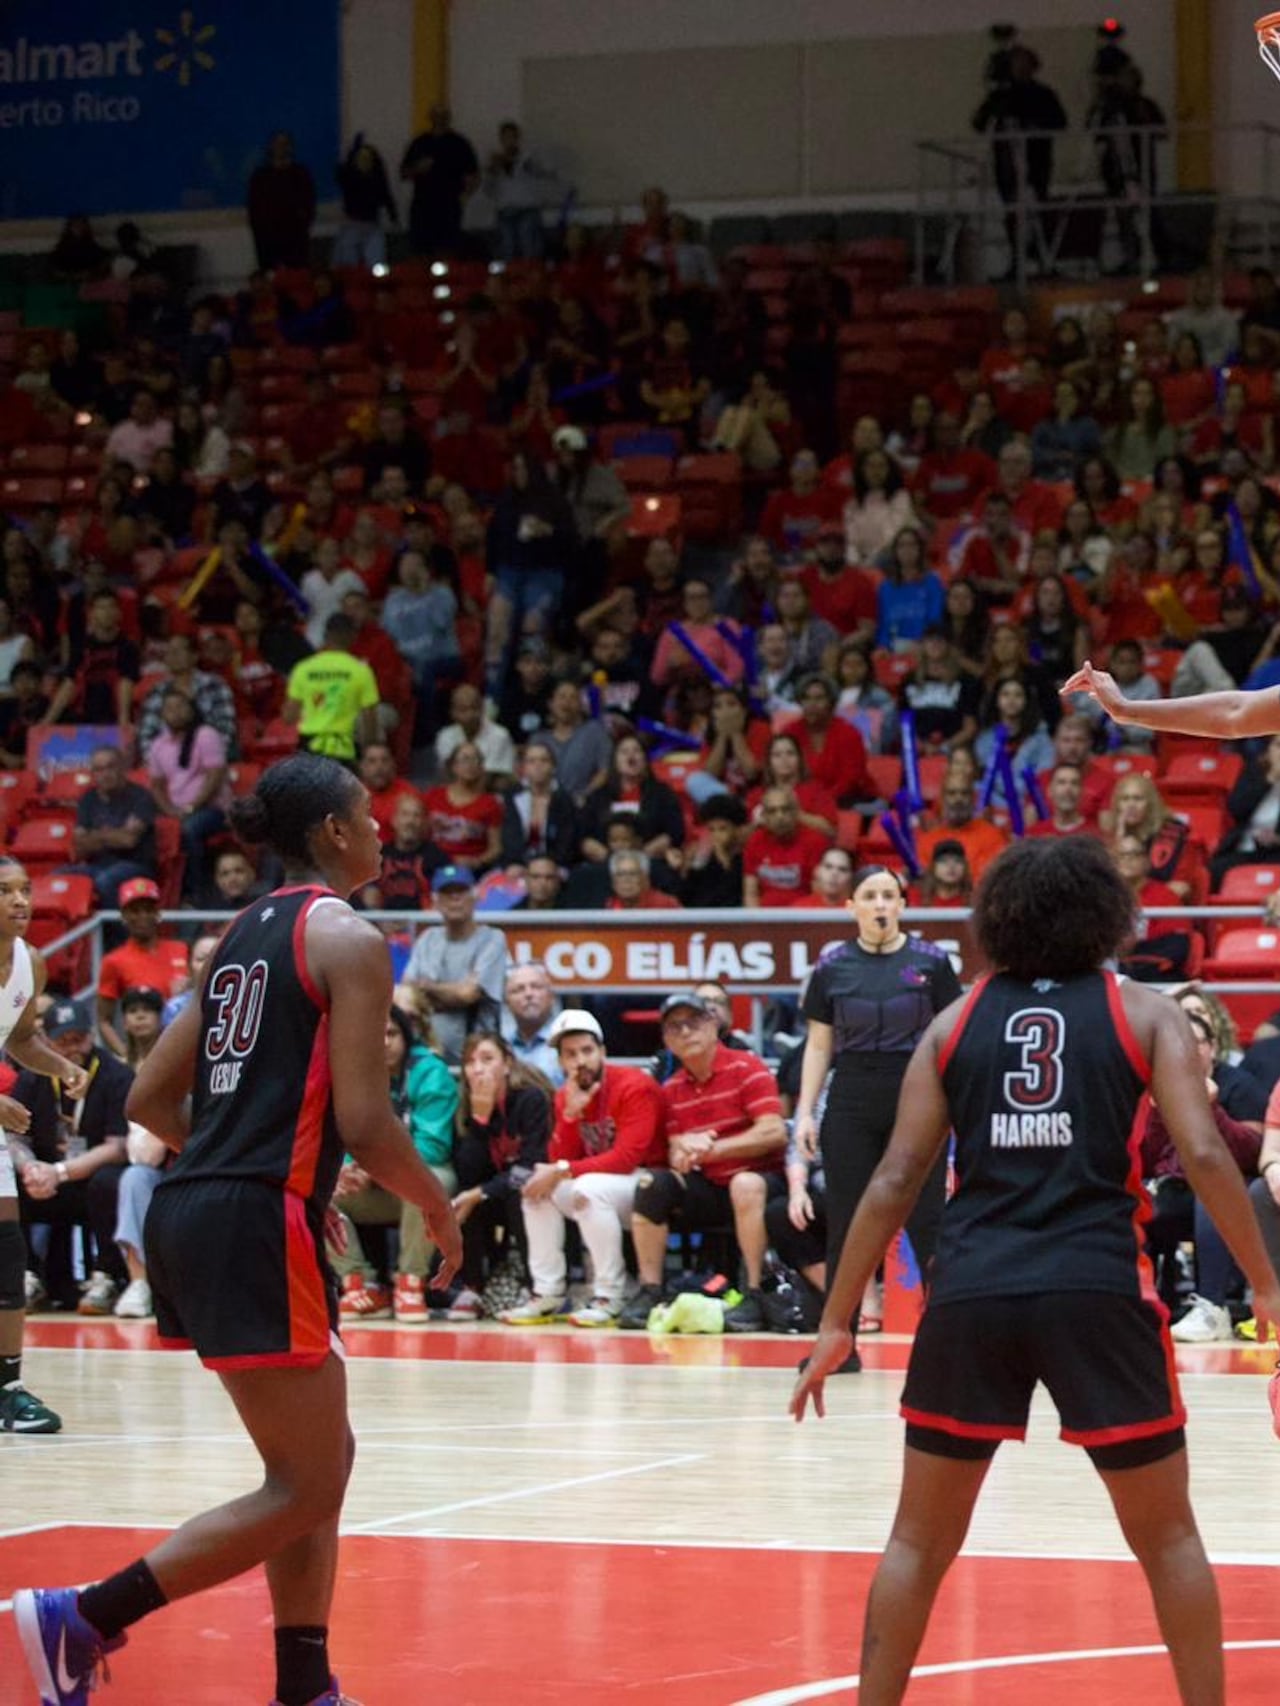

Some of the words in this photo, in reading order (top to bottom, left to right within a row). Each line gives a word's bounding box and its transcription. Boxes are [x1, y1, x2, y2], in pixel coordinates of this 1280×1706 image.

[72, 91, 141, 123] Rico
[626, 933, 775, 981] ELÍAS
[205, 959, 269, 1062] 30
[1003, 1006, 1066, 1112] 3
[990, 1111, 1074, 1148] HARRIS
